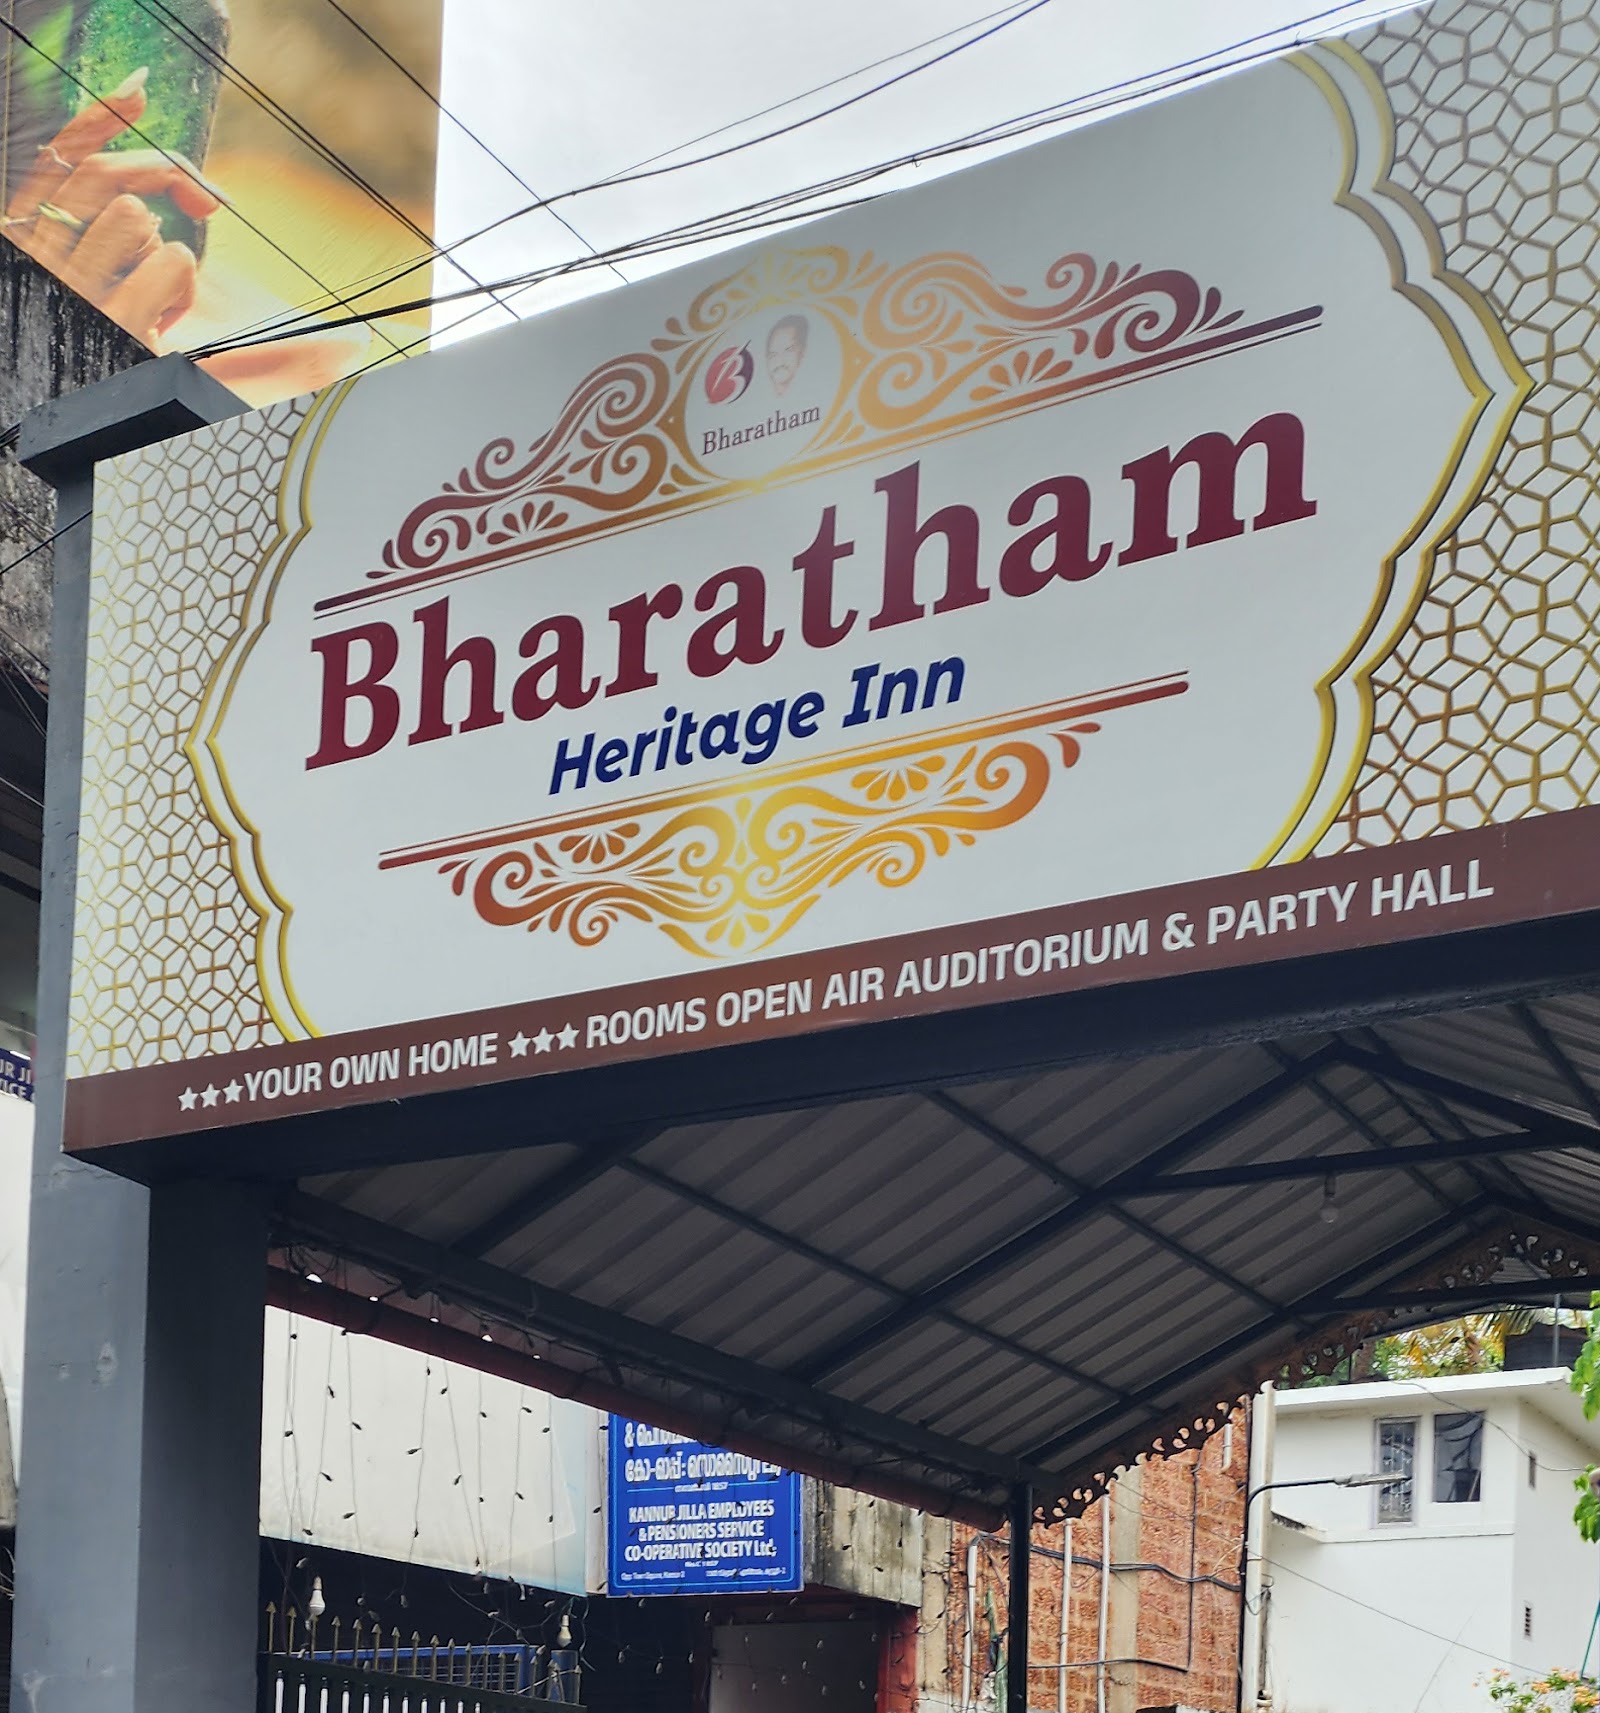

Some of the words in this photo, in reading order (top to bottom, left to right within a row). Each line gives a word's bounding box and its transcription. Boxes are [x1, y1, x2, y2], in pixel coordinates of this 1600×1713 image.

[701, 406, 821, 456] Bharatham
[305, 411, 1318, 771] Bharatham
[548, 690, 825, 795] Heritage
[842, 655, 966, 728] Inn
[244, 1062, 323, 1101] YOUR
[329, 1050, 400, 1089] OWN
[407, 1032, 499, 1077] HOME
[585, 998, 707, 1048] ROOMS
[715, 980, 812, 1028] OPEN
[822, 966, 885, 1010] AIR
[893, 918, 1149, 998] AUDITORIUM
[1162, 912, 1196, 952] &
[1207, 880, 1359, 944] PARTY
[1370, 859, 1495, 917] HALL
[628, 1505, 676, 1523] KANNUR
[677, 1502, 706, 1520] JILLA
[708, 1499, 775, 1519] EMPLOYEES
[648, 1522, 717, 1541] PENSIONERS
[717, 1520, 765, 1538] SERVICE
[624, 1542, 704, 1562] CO-OPERATIVE
[704, 1540, 753, 1558] SOCIETY
